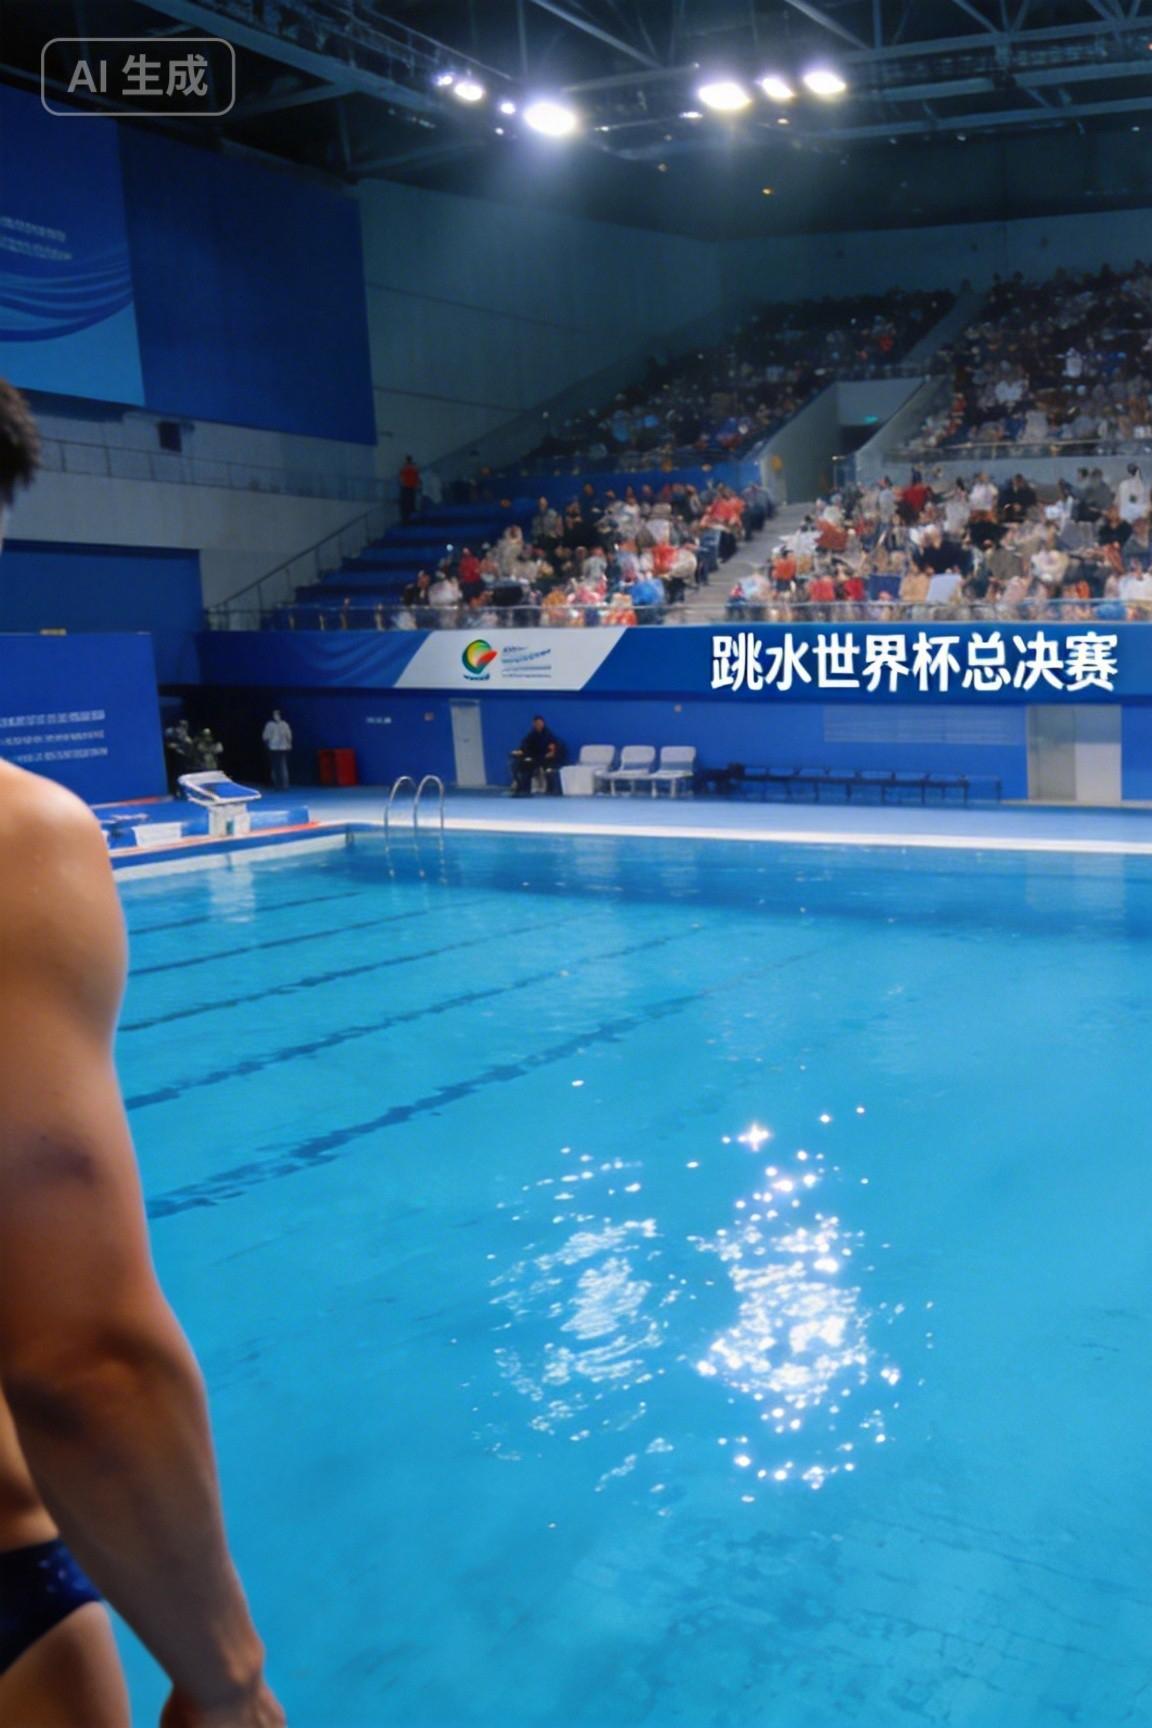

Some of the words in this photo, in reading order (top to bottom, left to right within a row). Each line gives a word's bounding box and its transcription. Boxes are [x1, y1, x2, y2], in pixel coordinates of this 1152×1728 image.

[711, 631, 1119, 692] 跳水世界杯总决赛
